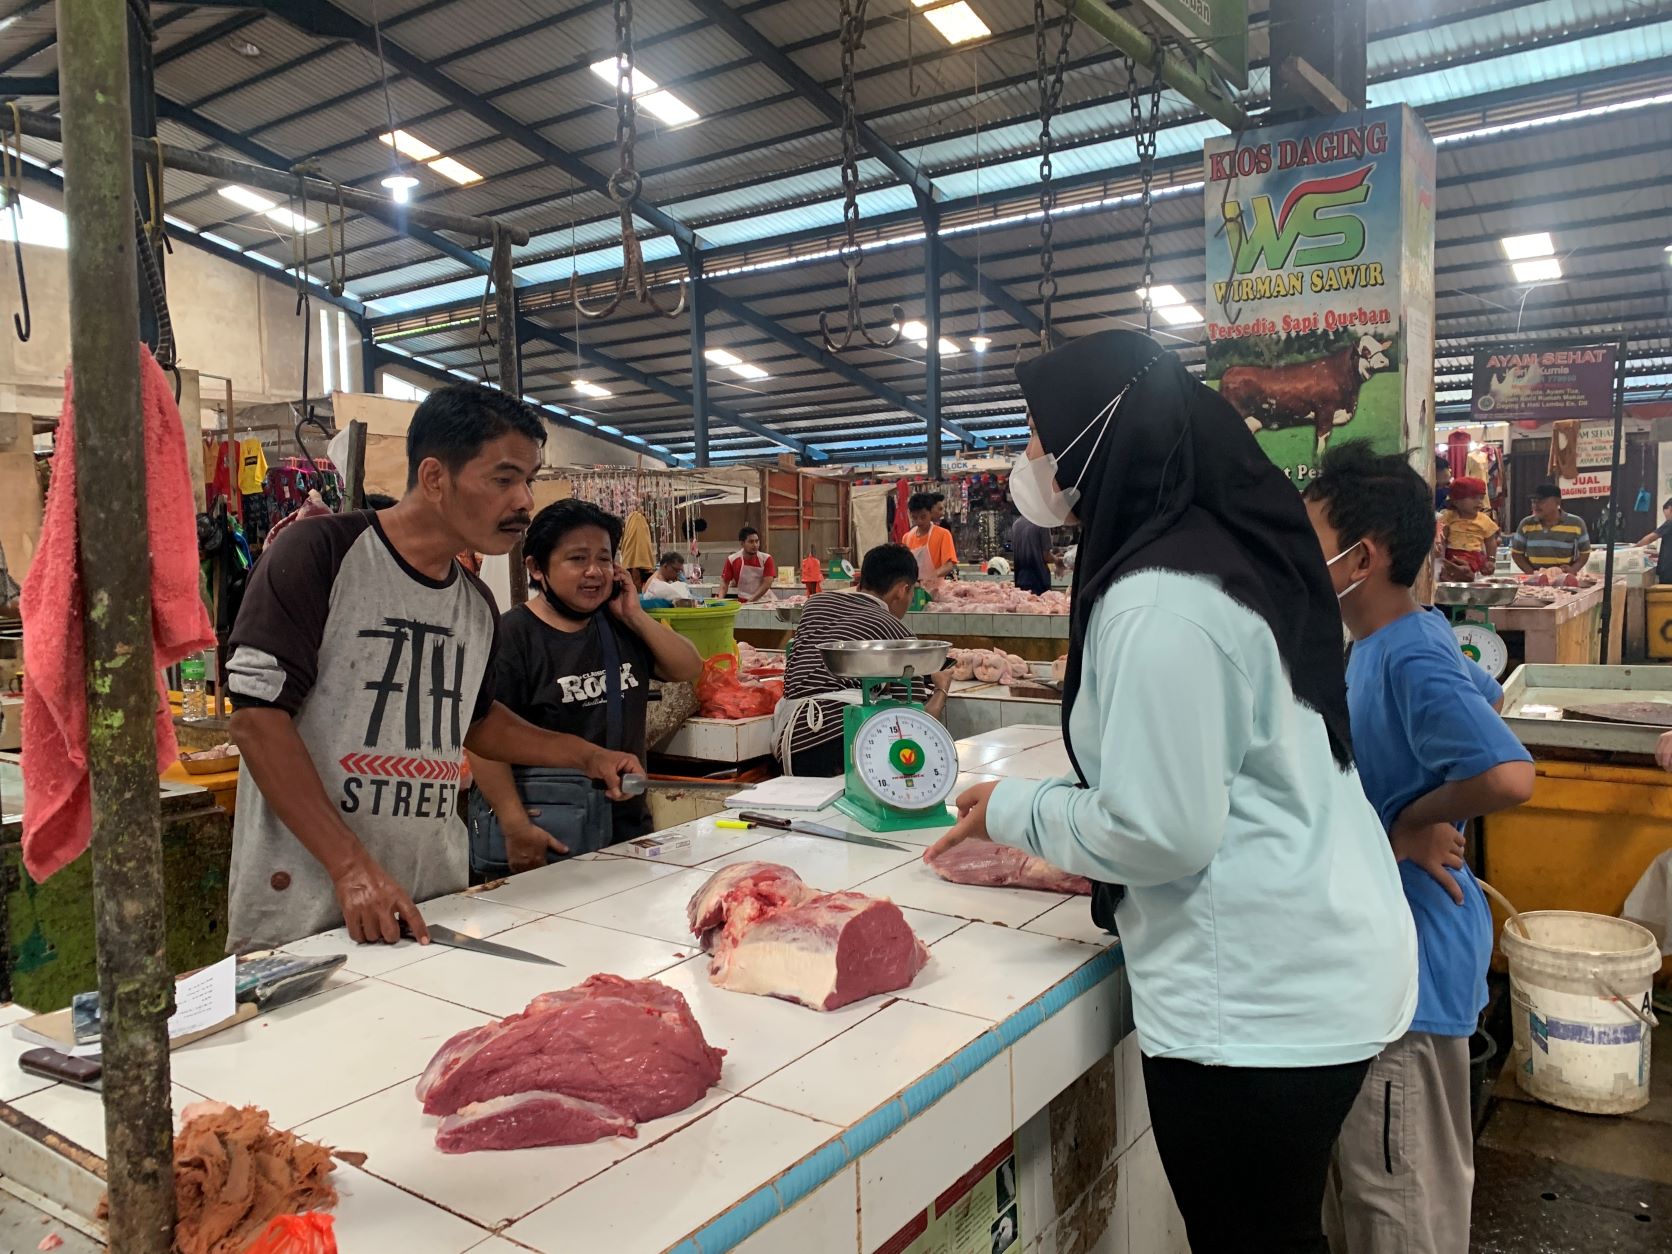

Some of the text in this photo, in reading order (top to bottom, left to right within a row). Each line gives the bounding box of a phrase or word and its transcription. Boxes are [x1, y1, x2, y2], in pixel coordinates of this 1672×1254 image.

[1209, 143, 1272, 182] KIOS
[1278, 122, 1388, 170] DAGING
[1223, 164, 1376, 275] WS
[1213, 262, 1385, 304] WIRMAN SAWIR
[1208, 318, 1276, 342] Tersedia
[1281, 311, 1319, 334] Sapi
[1324, 306, 1390, 329] Qurban
[1486, 350, 1607, 368] AYAM SEHAT
[1561, 487, 1587, 496] DAGING
[1572, 476, 1600, 485] JUAL
[356, 617, 466, 755] 7TH
[889, 726, 898, 734] 15
[933, 768, 939, 776] 5
